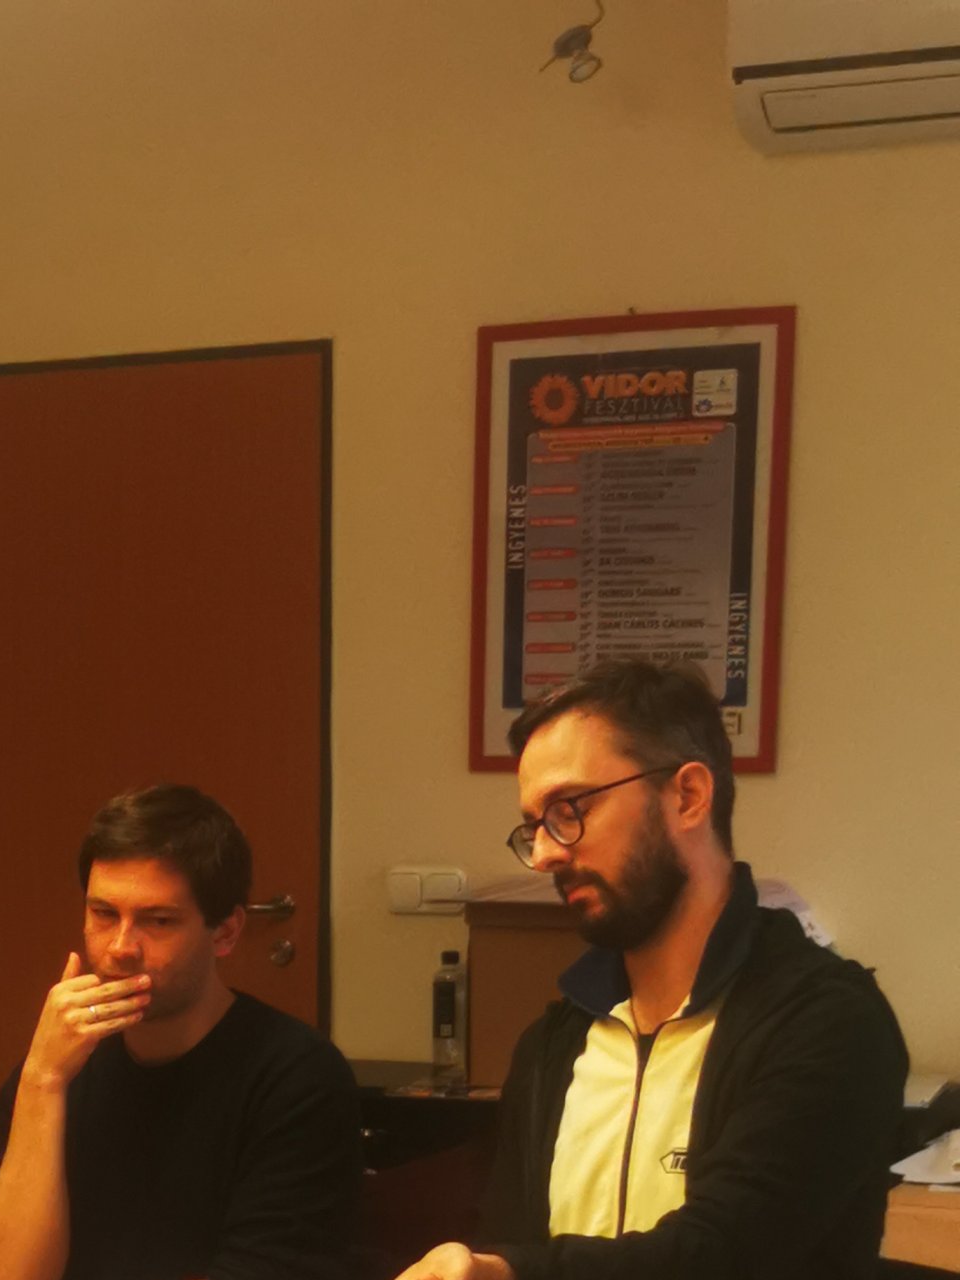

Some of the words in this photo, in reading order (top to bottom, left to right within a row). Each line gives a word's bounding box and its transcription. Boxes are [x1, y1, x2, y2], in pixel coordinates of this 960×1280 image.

[582, 370, 688, 399] VIDOR
[507, 484, 527, 570] INGYENES
[727, 592, 747, 679] INGYENES
